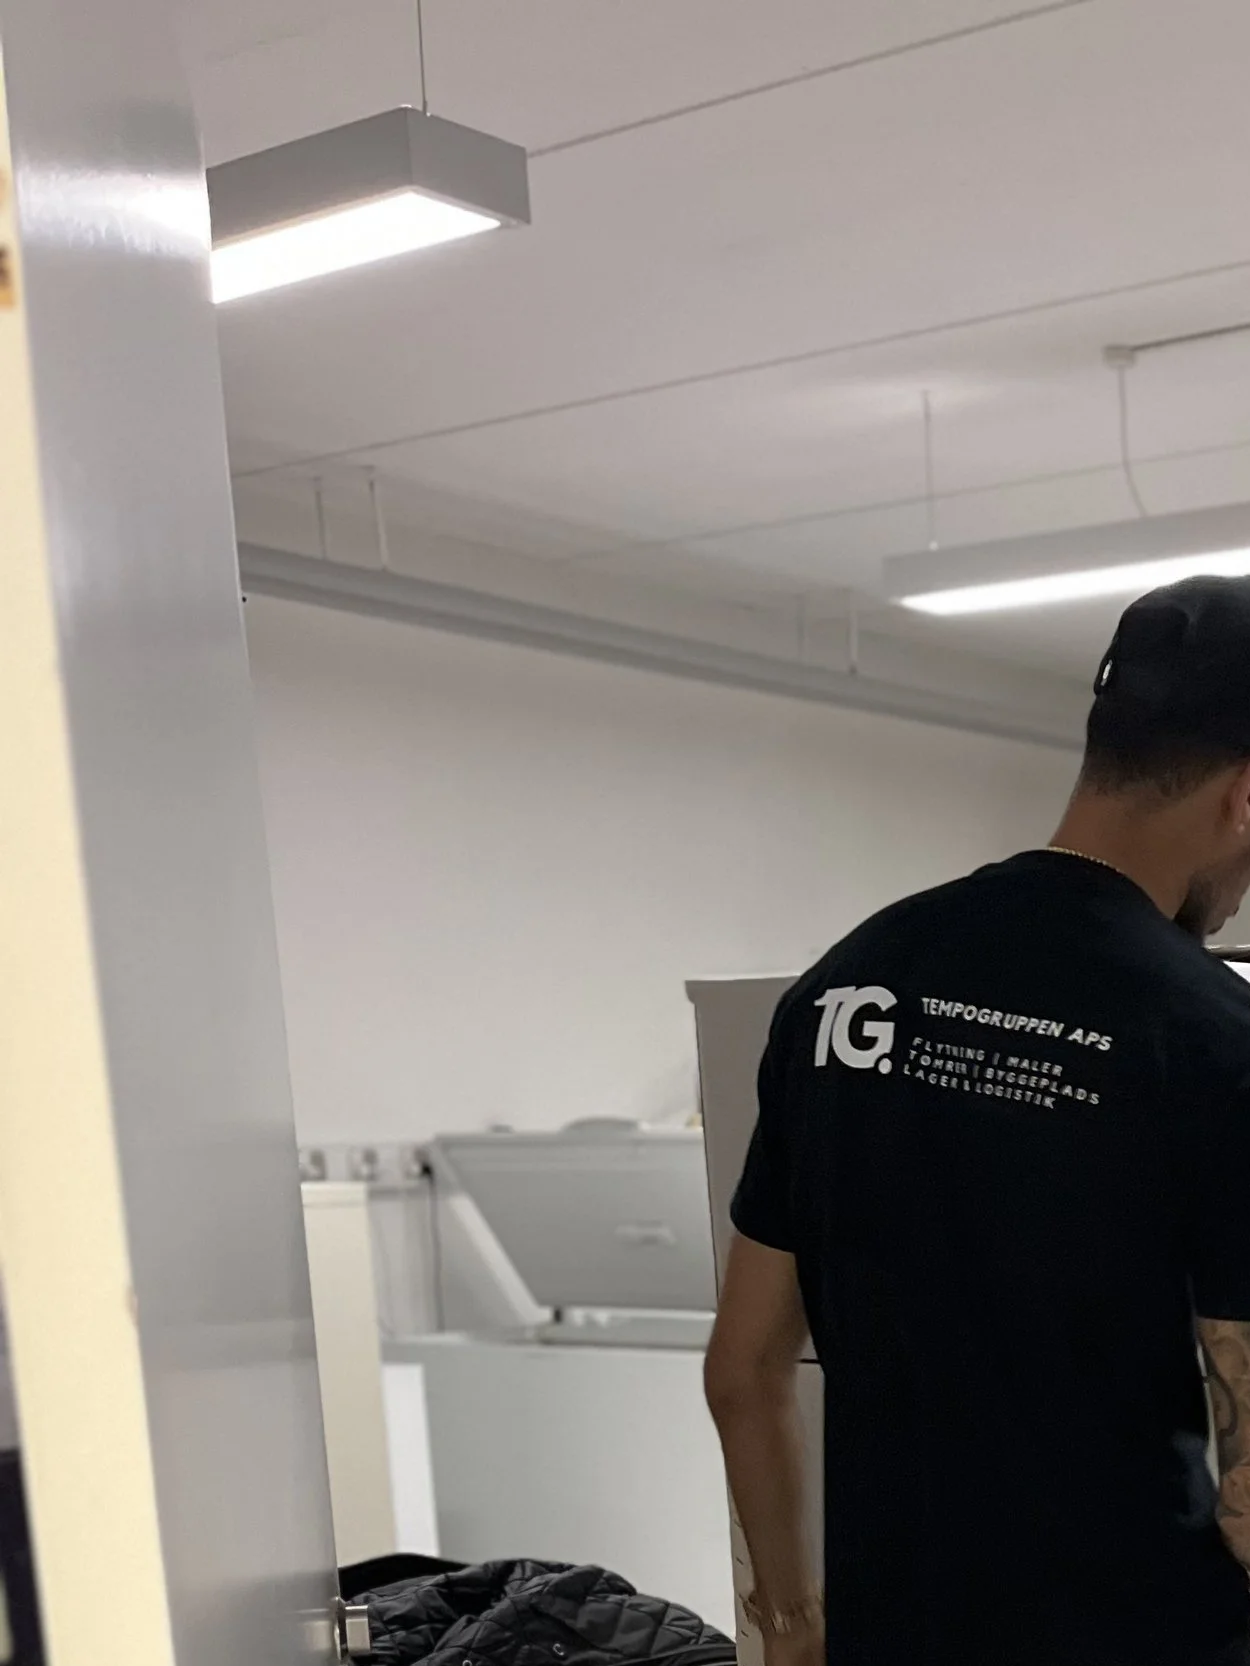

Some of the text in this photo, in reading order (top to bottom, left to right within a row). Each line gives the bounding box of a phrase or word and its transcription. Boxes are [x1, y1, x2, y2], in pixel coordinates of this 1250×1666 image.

[921, 997, 1113, 1051] TEMPOGRUPPEN APS
[1006, 1056, 1063, 1077] MALER
[975, 1082, 1056, 1109] LOGISTIK
[984, 1067, 1100, 1105] BYGGEPLADS
